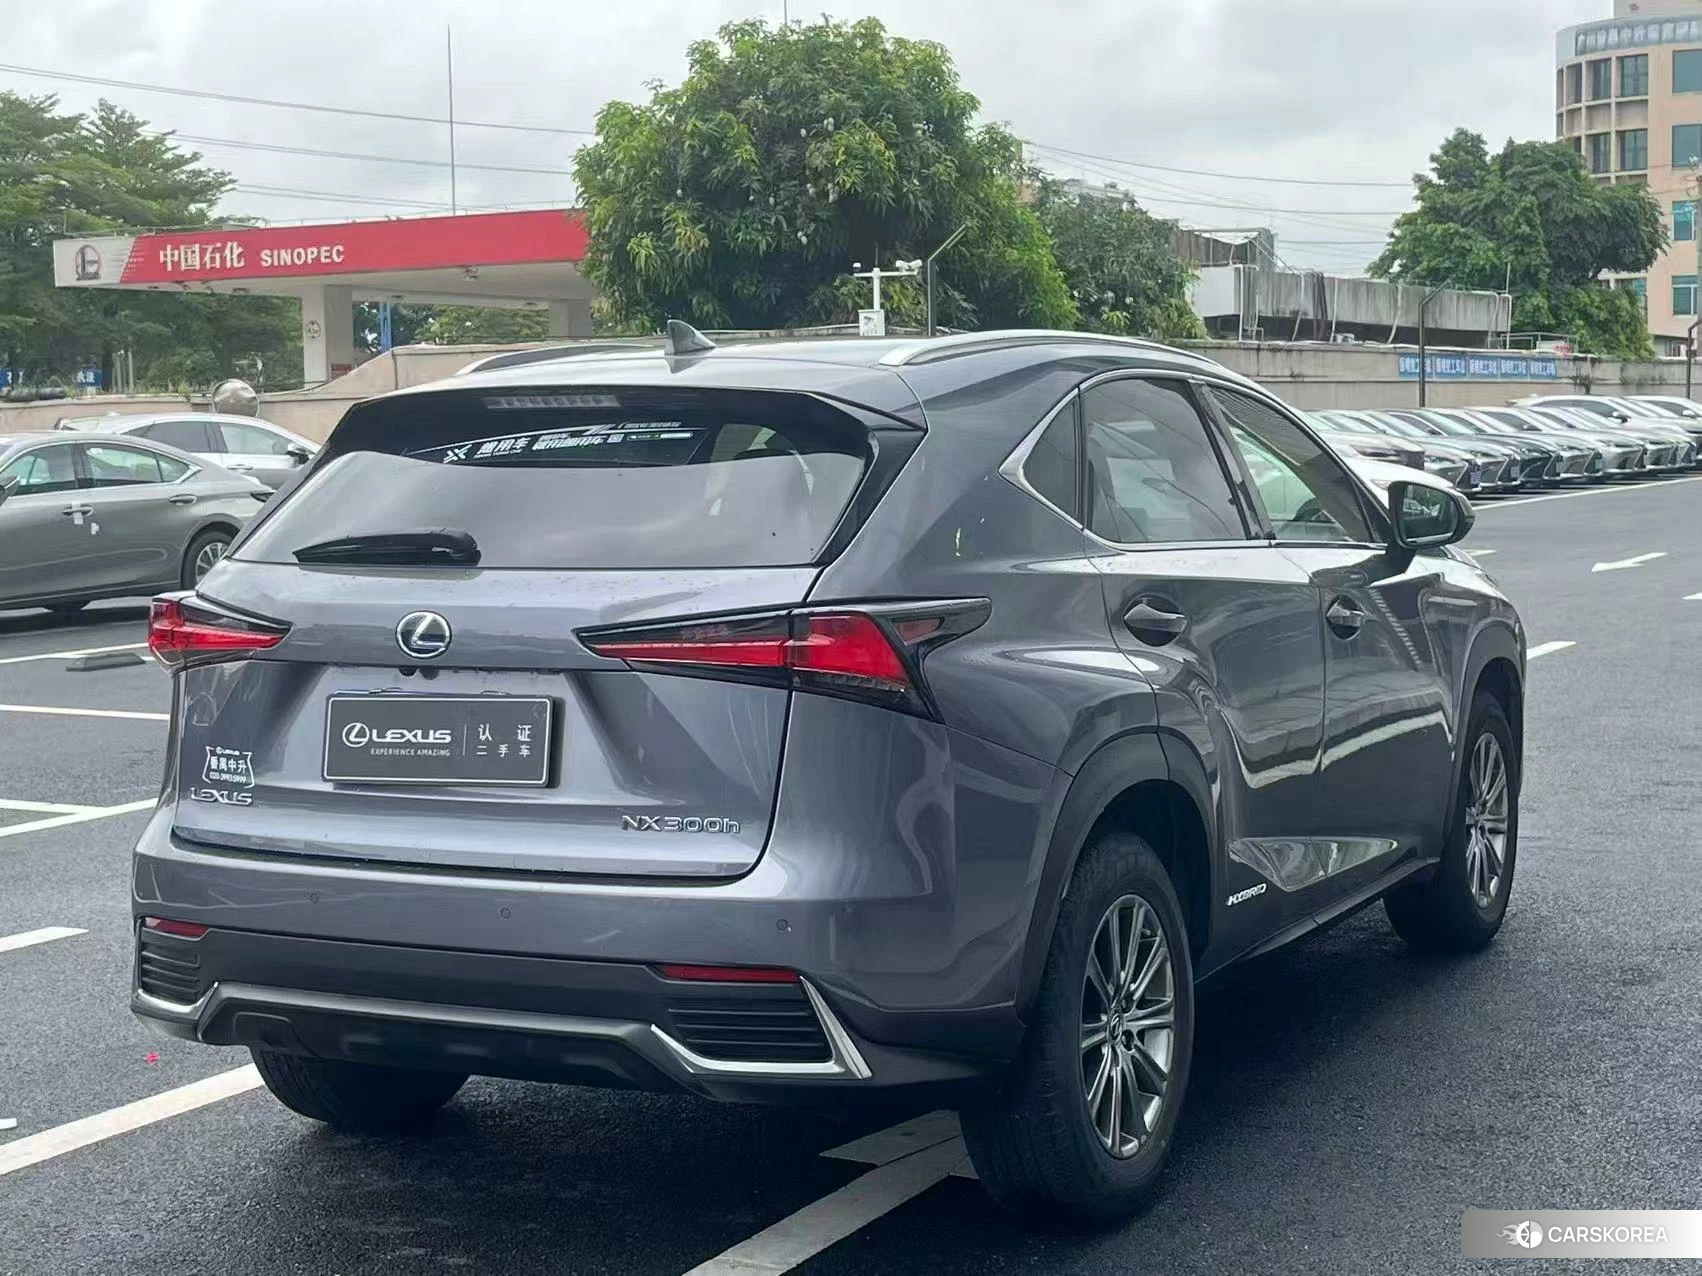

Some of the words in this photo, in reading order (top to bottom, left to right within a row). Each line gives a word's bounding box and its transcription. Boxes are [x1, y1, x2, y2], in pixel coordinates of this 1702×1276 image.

[159, 241, 245, 272] 中国石化
[260, 244, 345, 268] SINOPEC
[371, 728, 452, 744] LEXUS
[370, 747, 415, 757] EXPERIENCE
[416, 748, 451, 757] AMAZING
[190, 786, 252, 805] LEXUS
[1226, 882, 1268, 906] HYBRID
